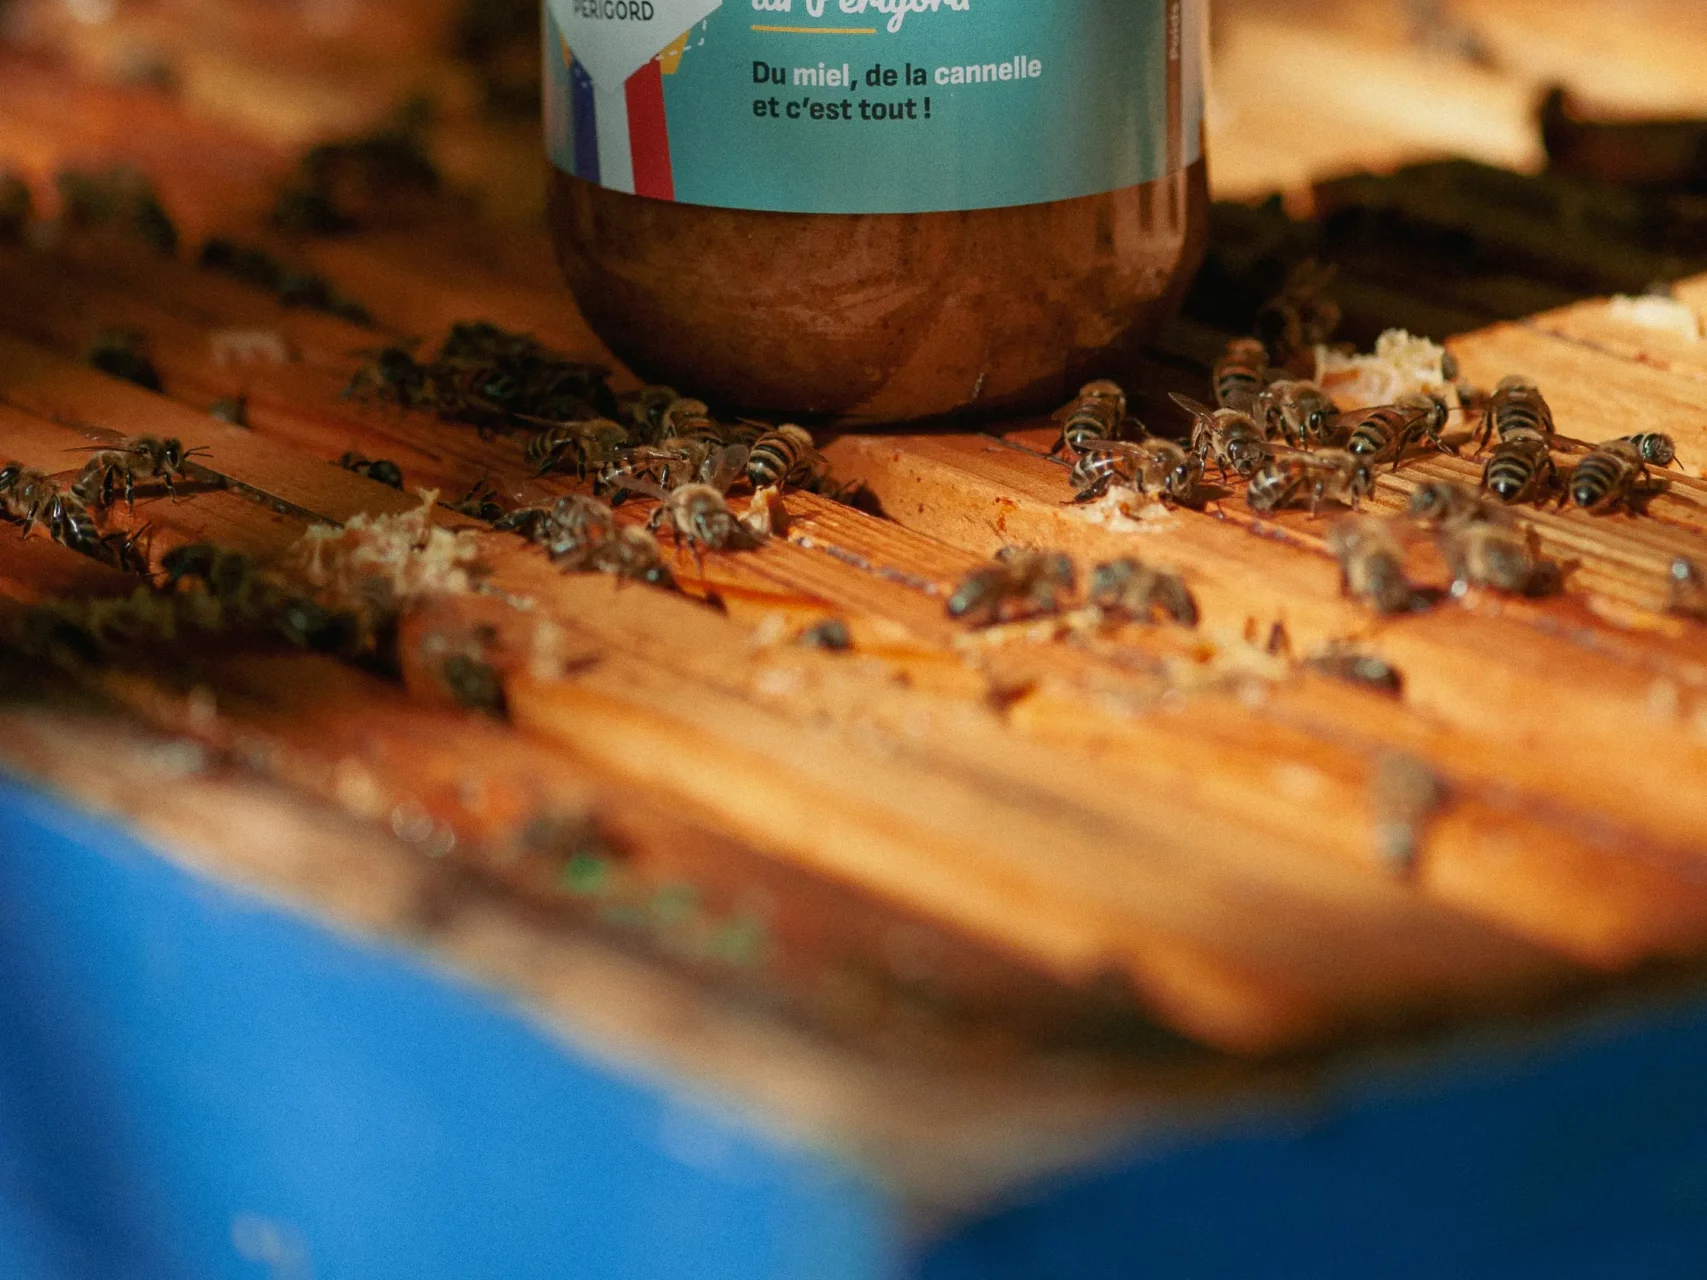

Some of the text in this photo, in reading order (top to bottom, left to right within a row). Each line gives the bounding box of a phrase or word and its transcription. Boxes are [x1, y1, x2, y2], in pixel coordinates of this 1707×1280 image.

[752, 55, 1042, 91] Du miel, de la cannelle
[752, 96, 780, 118] et
[786, 96, 853, 120] c'est
